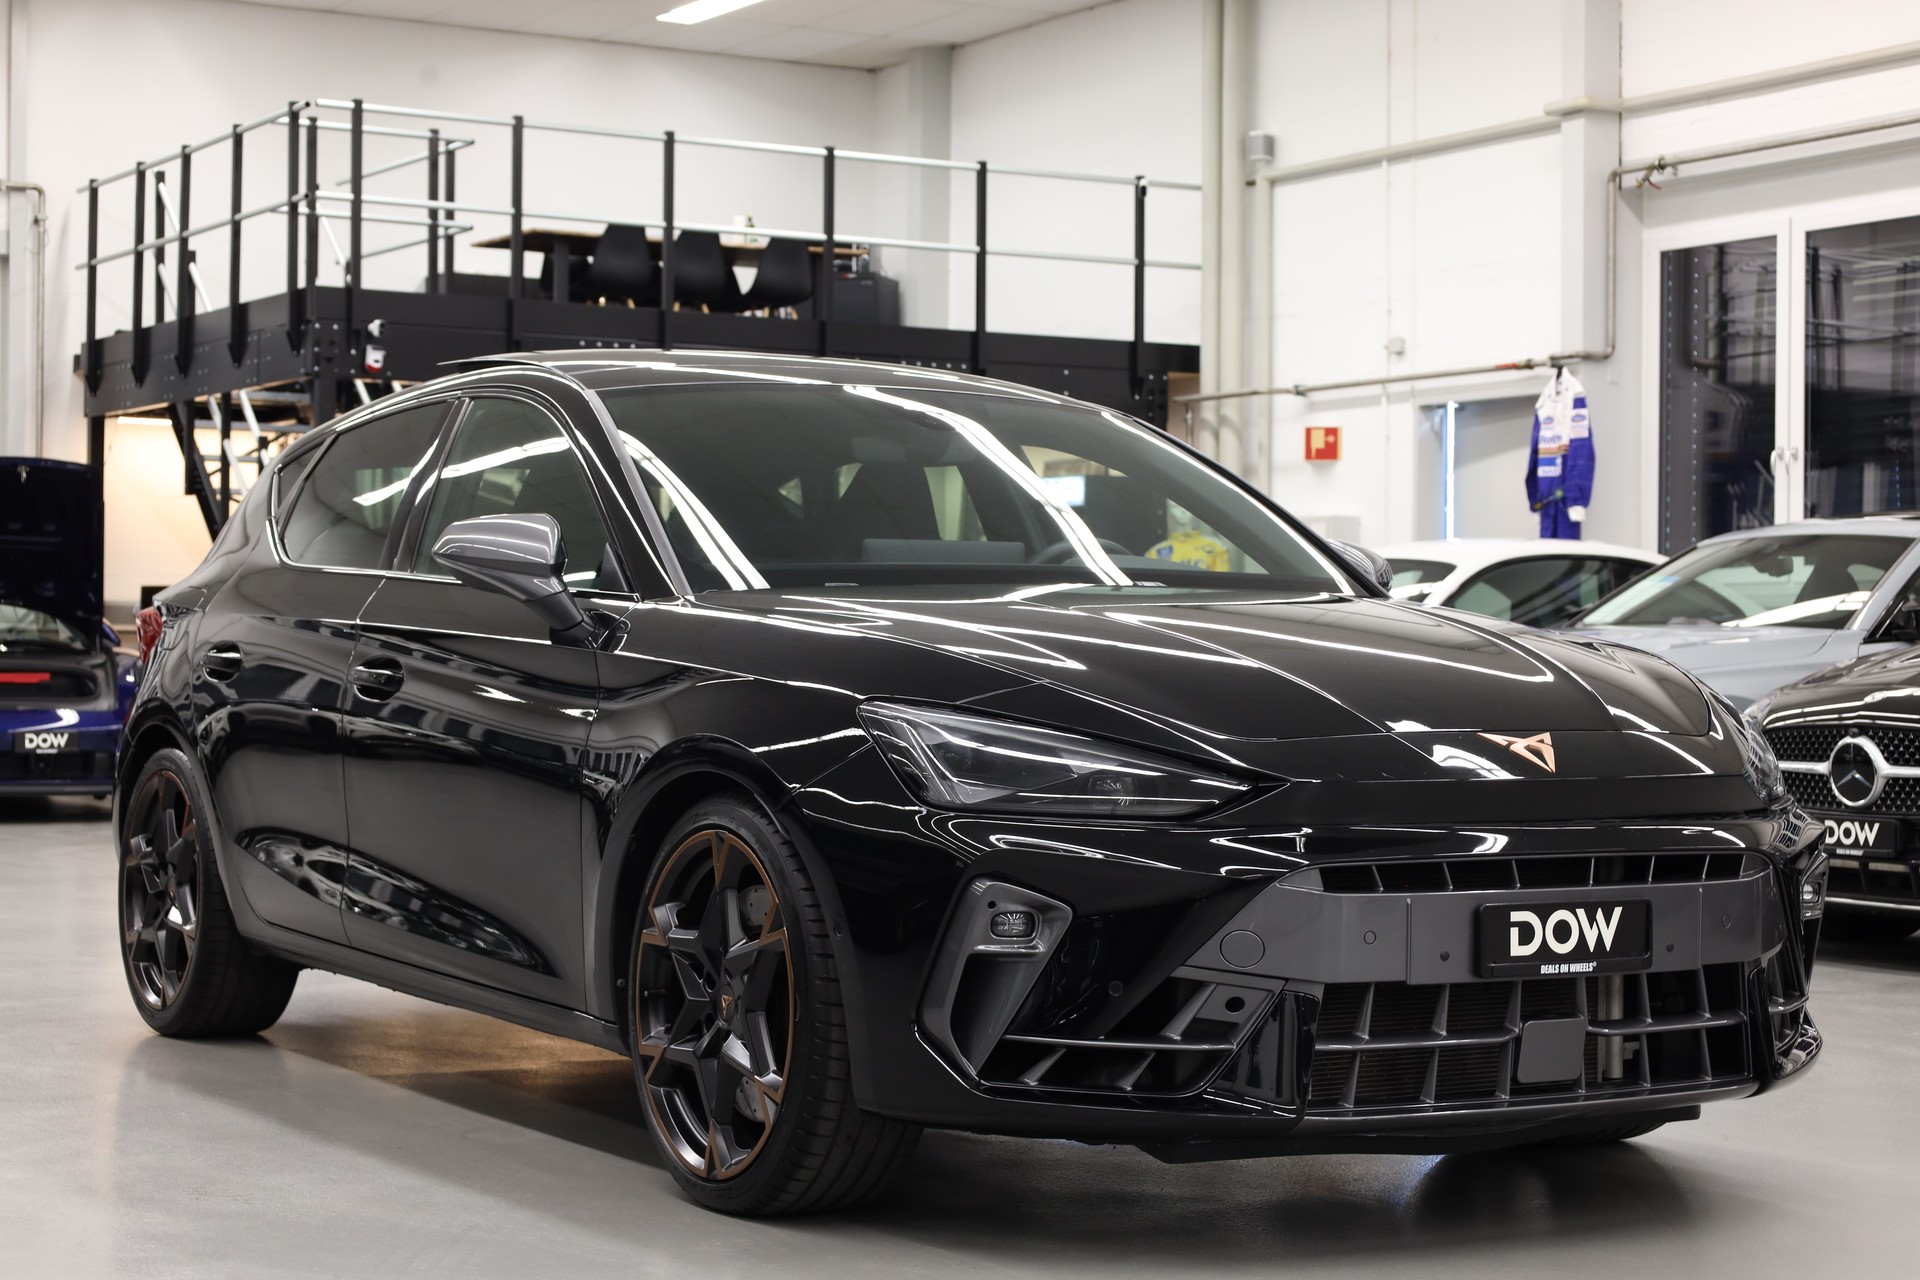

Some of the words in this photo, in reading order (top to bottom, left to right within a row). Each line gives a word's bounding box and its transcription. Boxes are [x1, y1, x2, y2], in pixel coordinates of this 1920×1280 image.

[24, 732, 69, 749] DOW
[1824, 819, 1880, 847] DOW
[1510, 906, 1623, 957] DOW
[1540, 964, 1559, 974] DEALS
[1560, 963, 1569, 973] ON
